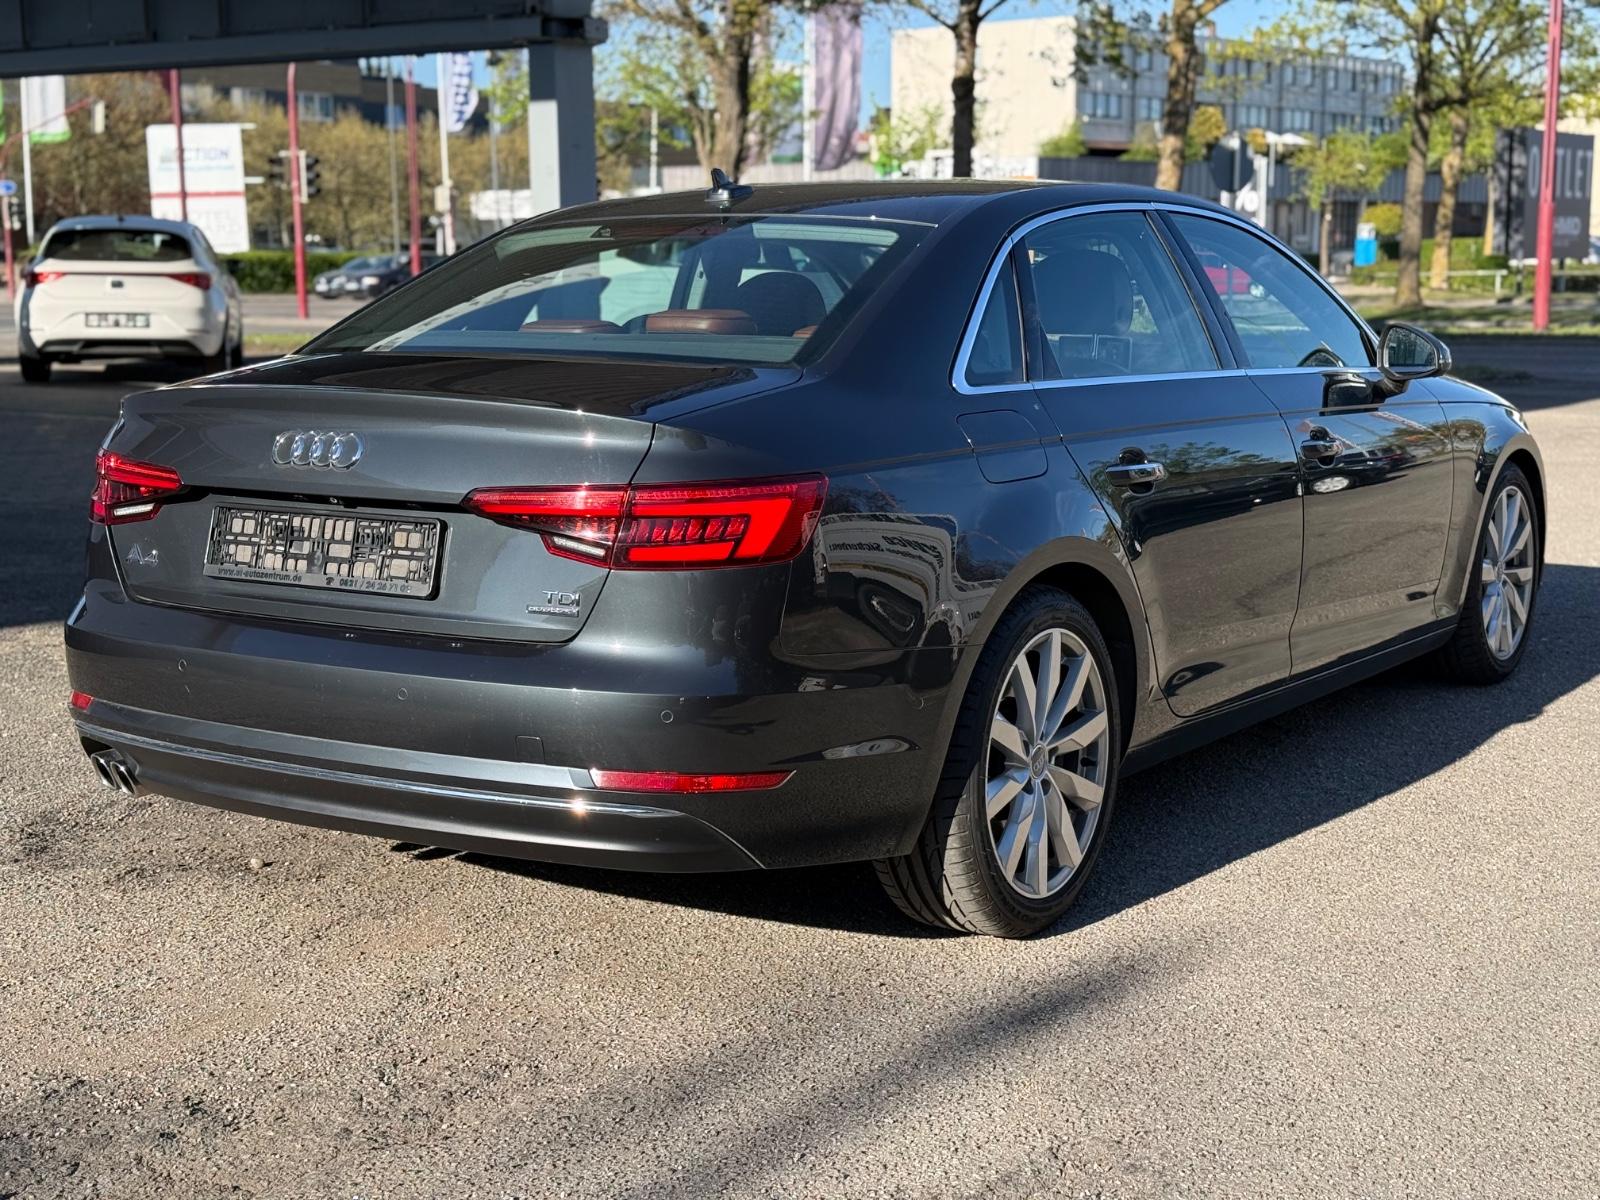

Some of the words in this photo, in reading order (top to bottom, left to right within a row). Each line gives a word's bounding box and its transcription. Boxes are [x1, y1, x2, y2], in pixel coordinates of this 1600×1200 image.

[1528, 145, 1593, 199] OTLET
[126, 543, 159, 569] A4
[542, 590, 580, 607] TDI
